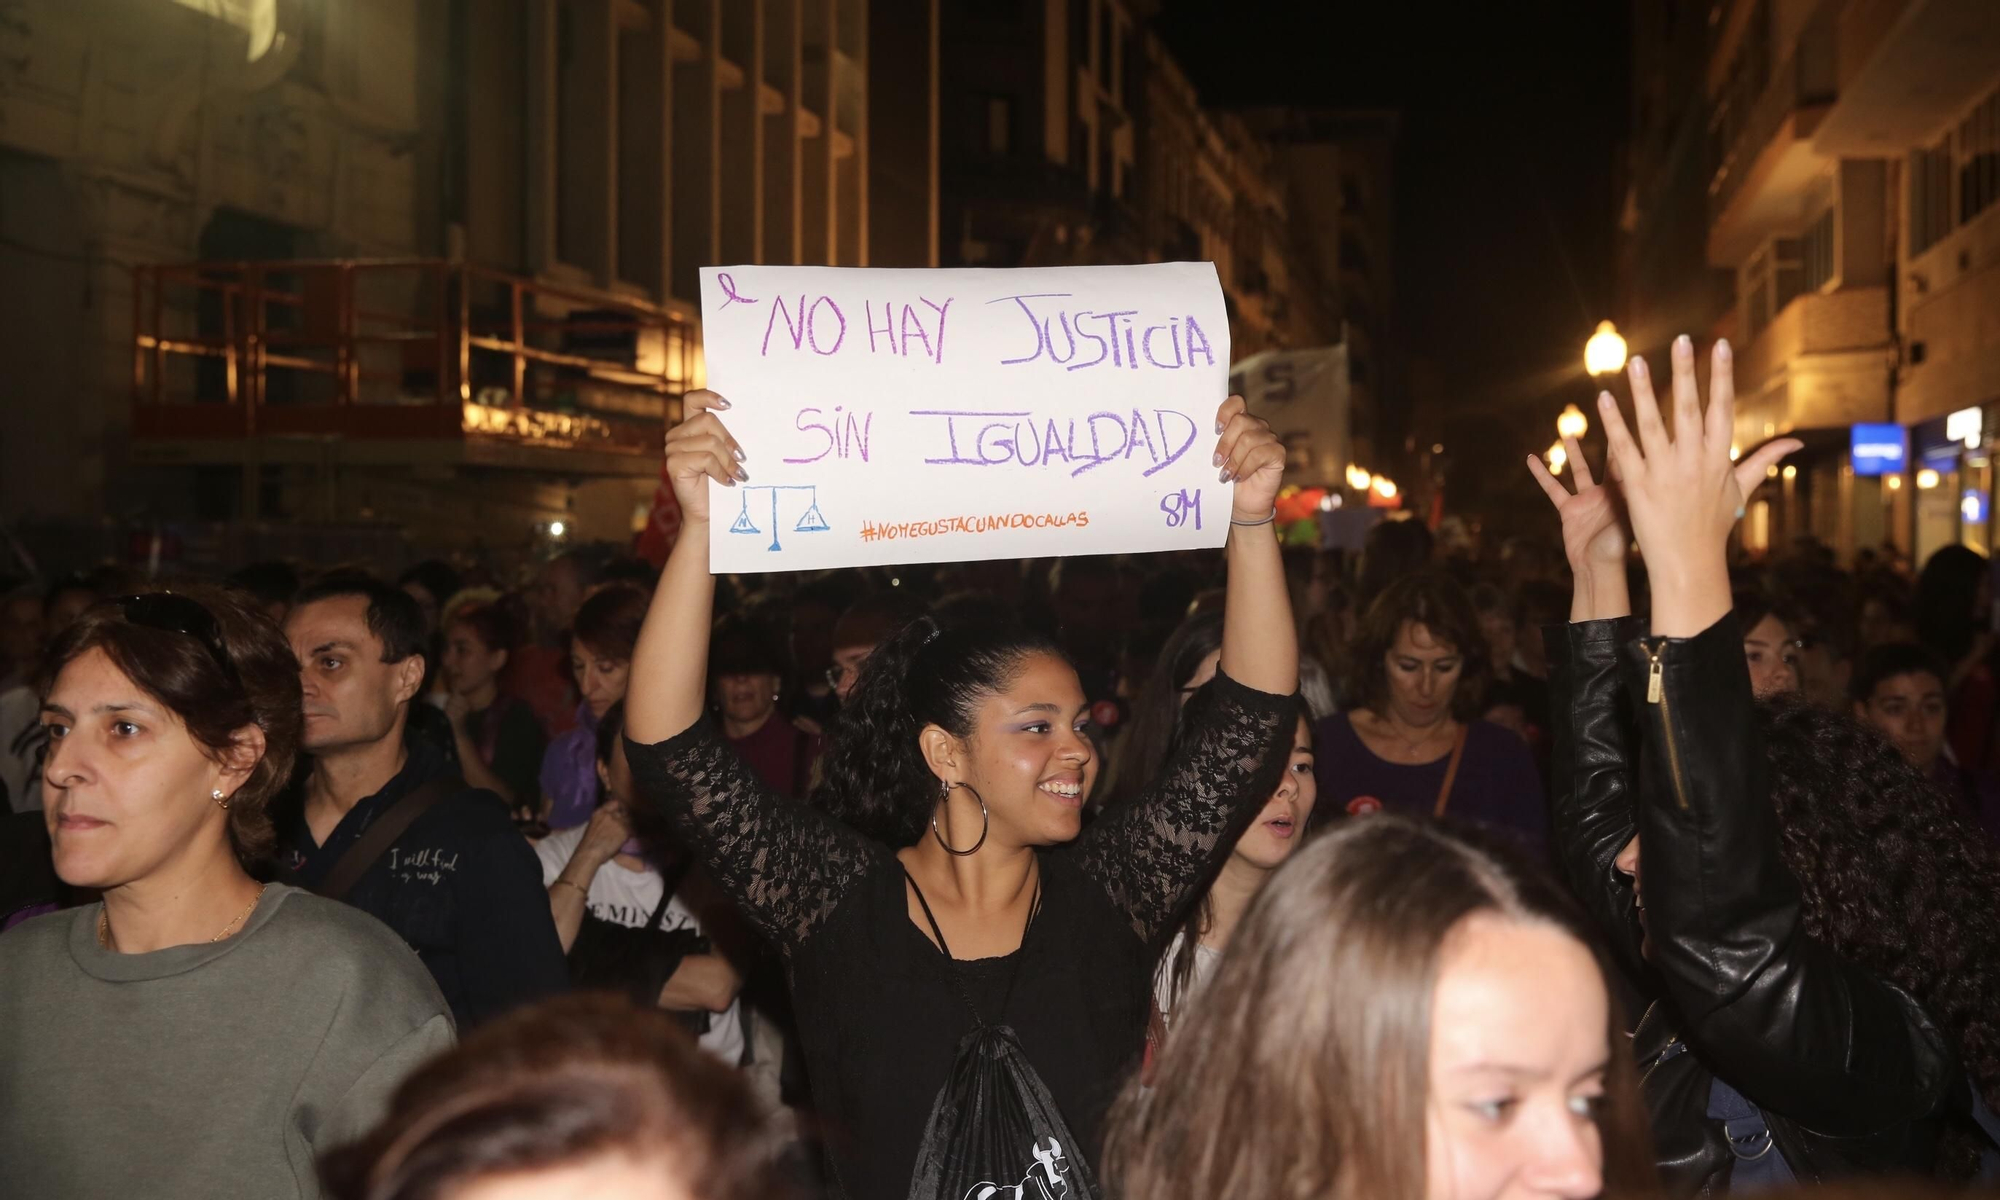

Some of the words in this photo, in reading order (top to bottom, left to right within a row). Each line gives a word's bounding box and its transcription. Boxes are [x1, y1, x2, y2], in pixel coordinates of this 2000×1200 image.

[761, 294, 848, 357] NO
[865, 296, 955, 364] HAY
[908, 408, 1198, 478] IGUALDAD
[859, 511, 1090, 543] #NOMEGUSTACUANDOCALLAS
[1160, 488, 1202, 531] 8M
[389, 847, 401, 870] I
[403, 848, 431, 868] will
[431, 848, 459, 872] find
[416, 871, 442, 886] way
